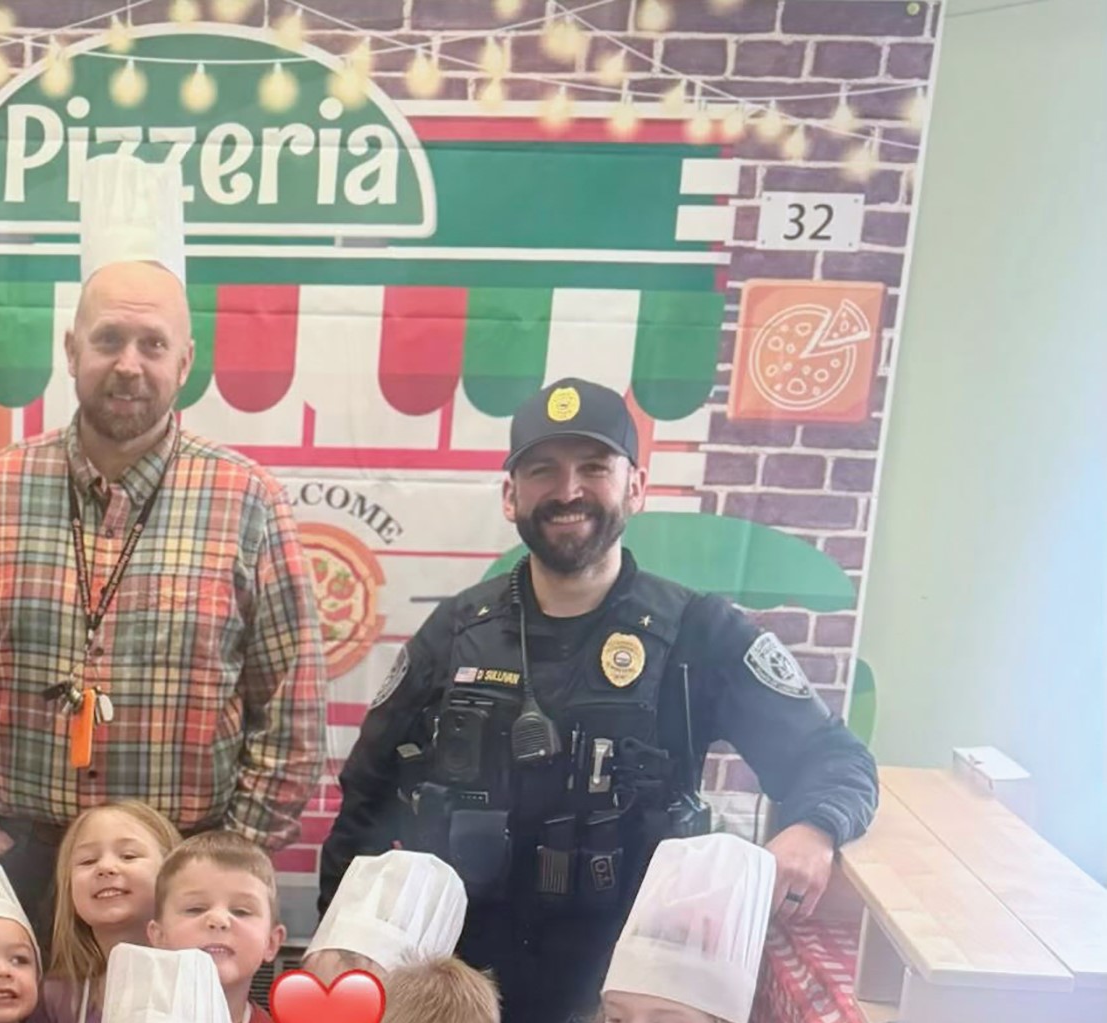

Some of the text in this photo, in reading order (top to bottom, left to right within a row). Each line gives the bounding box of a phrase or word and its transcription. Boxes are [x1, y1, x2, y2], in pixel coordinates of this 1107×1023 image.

[783, 203, 834, 241] 32
[292, 482, 403, 545] COME
[484, 669, 521, 685] SULLIVAN
